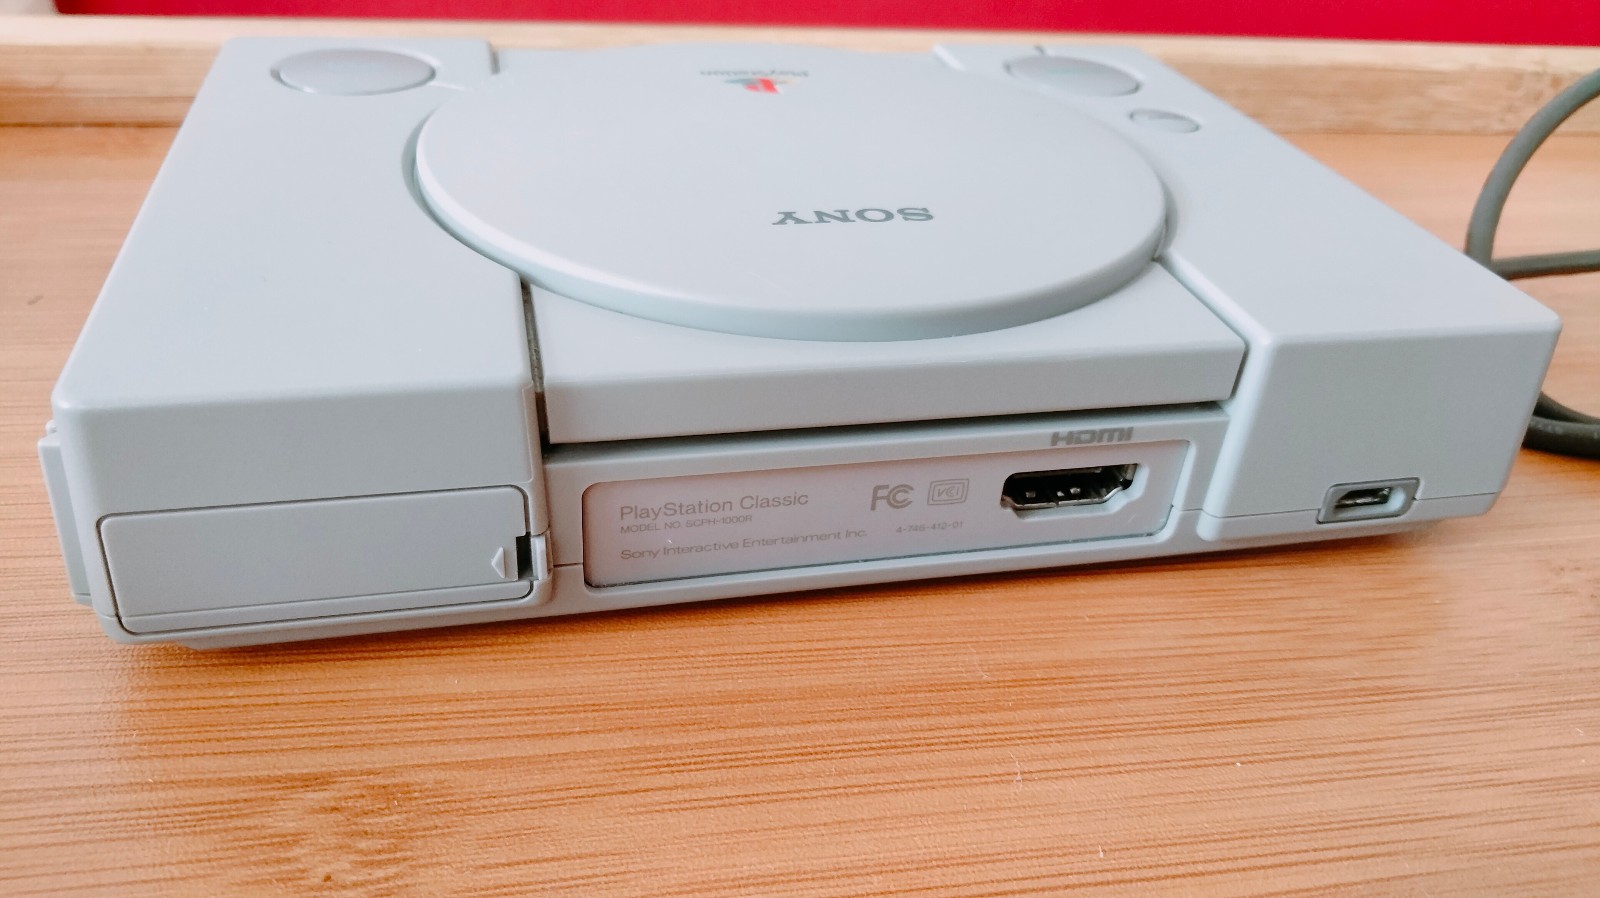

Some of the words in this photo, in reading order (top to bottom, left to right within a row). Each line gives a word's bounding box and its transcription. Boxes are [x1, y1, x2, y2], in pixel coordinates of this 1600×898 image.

[772, 206, 934, 226] SONY
[1051, 427, 1134, 447] HDMI
[620, 498, 733, 521] PlayStation
[739, 491, 809, 511] Classic
[620, 523, 661, 534] MODEL
[685, 514, 753, 528] SCPH-1000R
[620, 549, 658, 560] Sony
[663, 542, 740, 556] Interactive
[742, 531, 842, 549] Entertainment
[845, 528, 868, 538] Inc.
